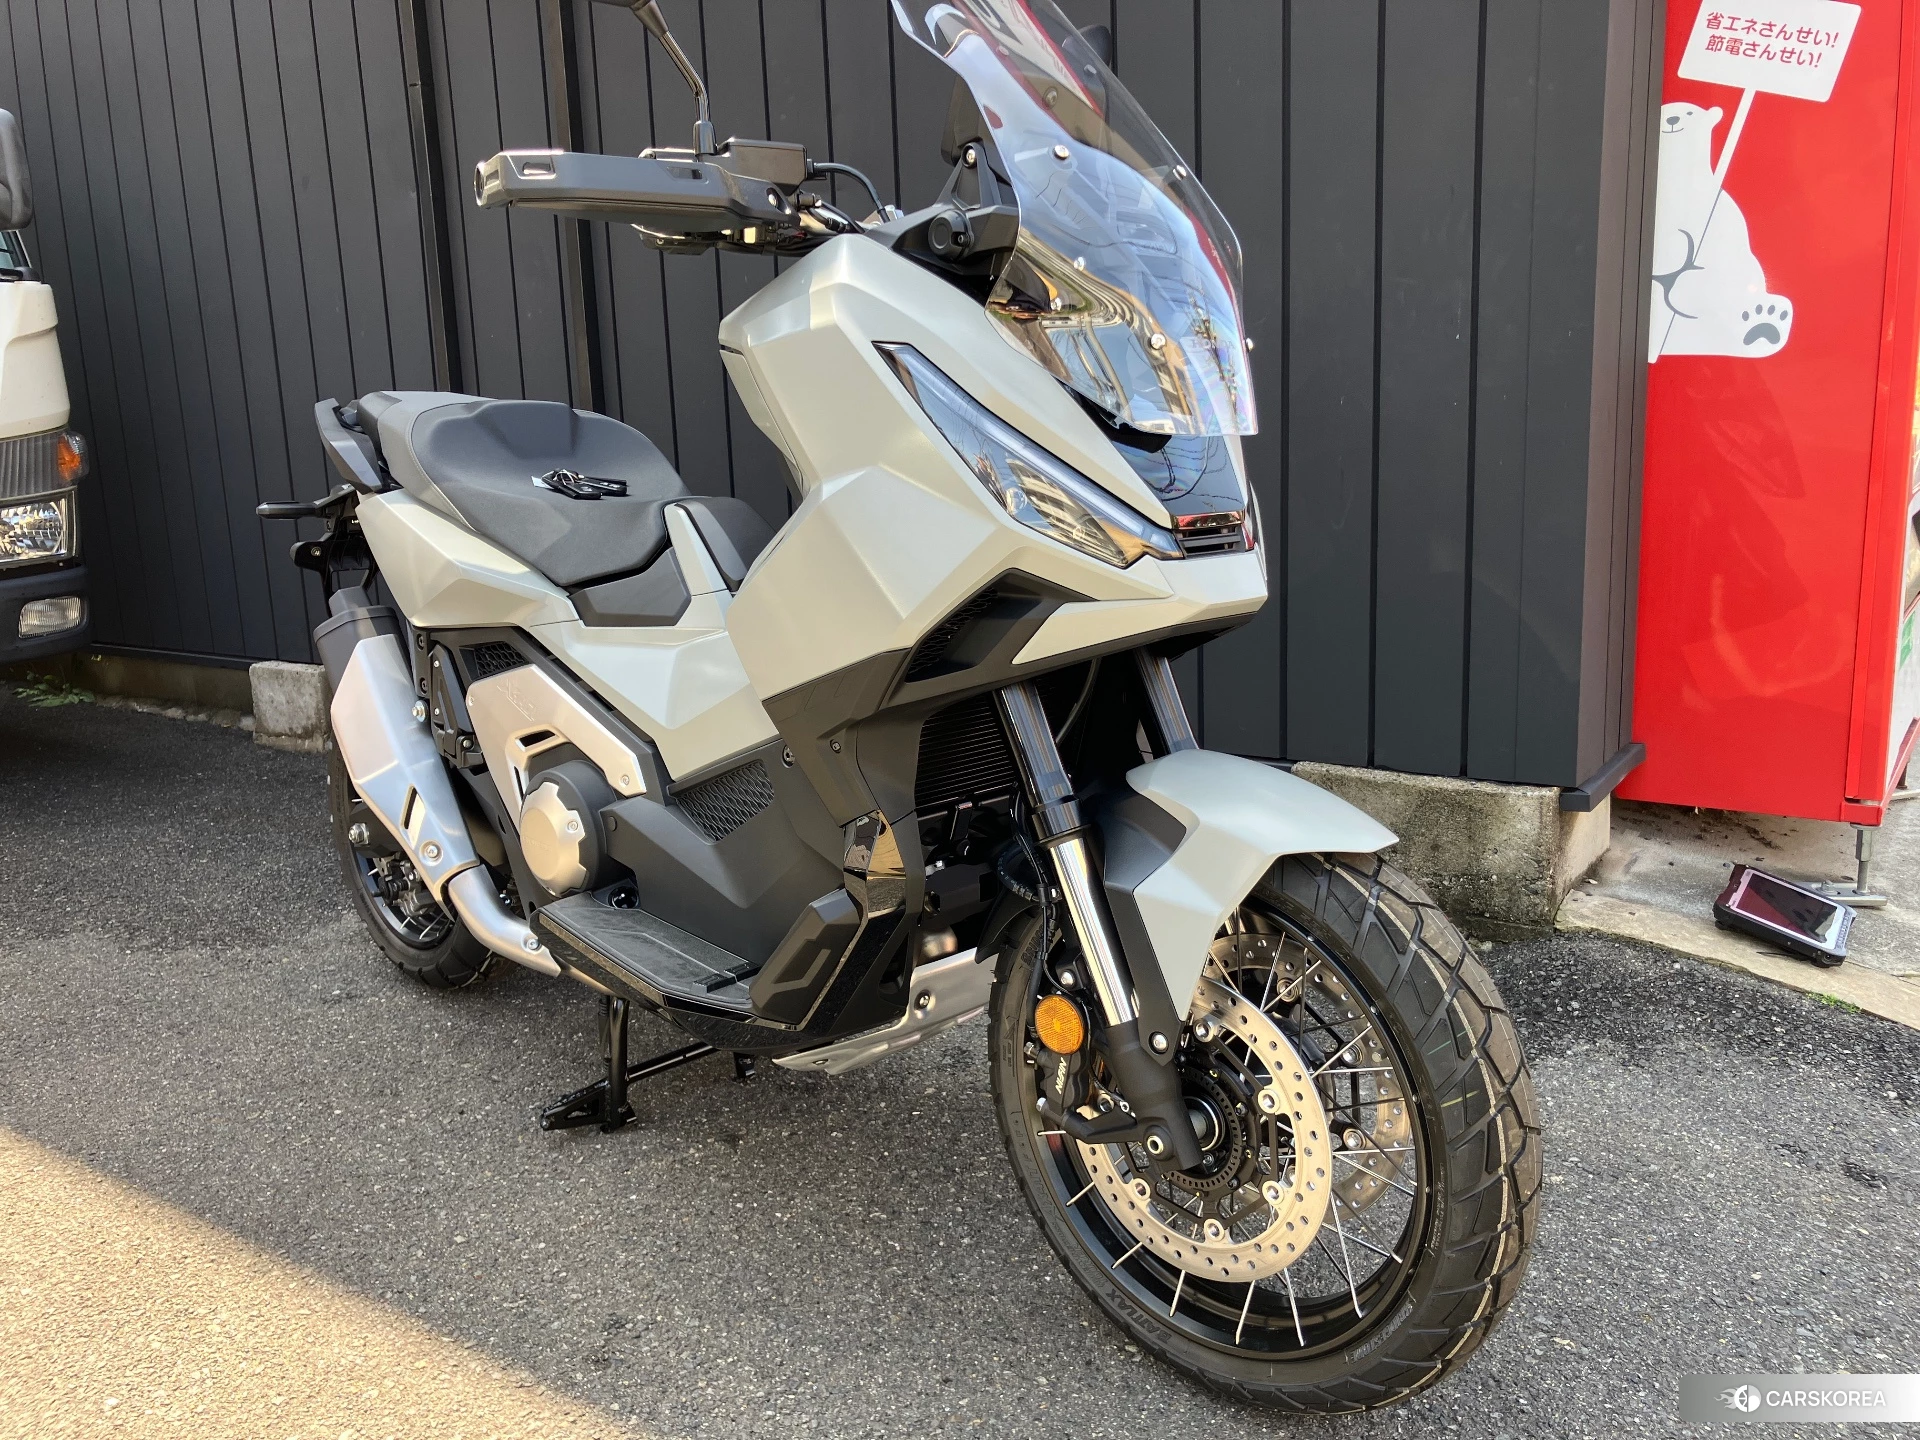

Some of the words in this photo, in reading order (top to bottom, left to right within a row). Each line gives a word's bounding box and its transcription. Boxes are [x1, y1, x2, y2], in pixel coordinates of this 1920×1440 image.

[1706, 11, 1839, 48] 省エネさんせい!
[1705, 33, 1822, 68] 節電さんせい!
[1106, 1288, 1172, 1344] BATTLAX
